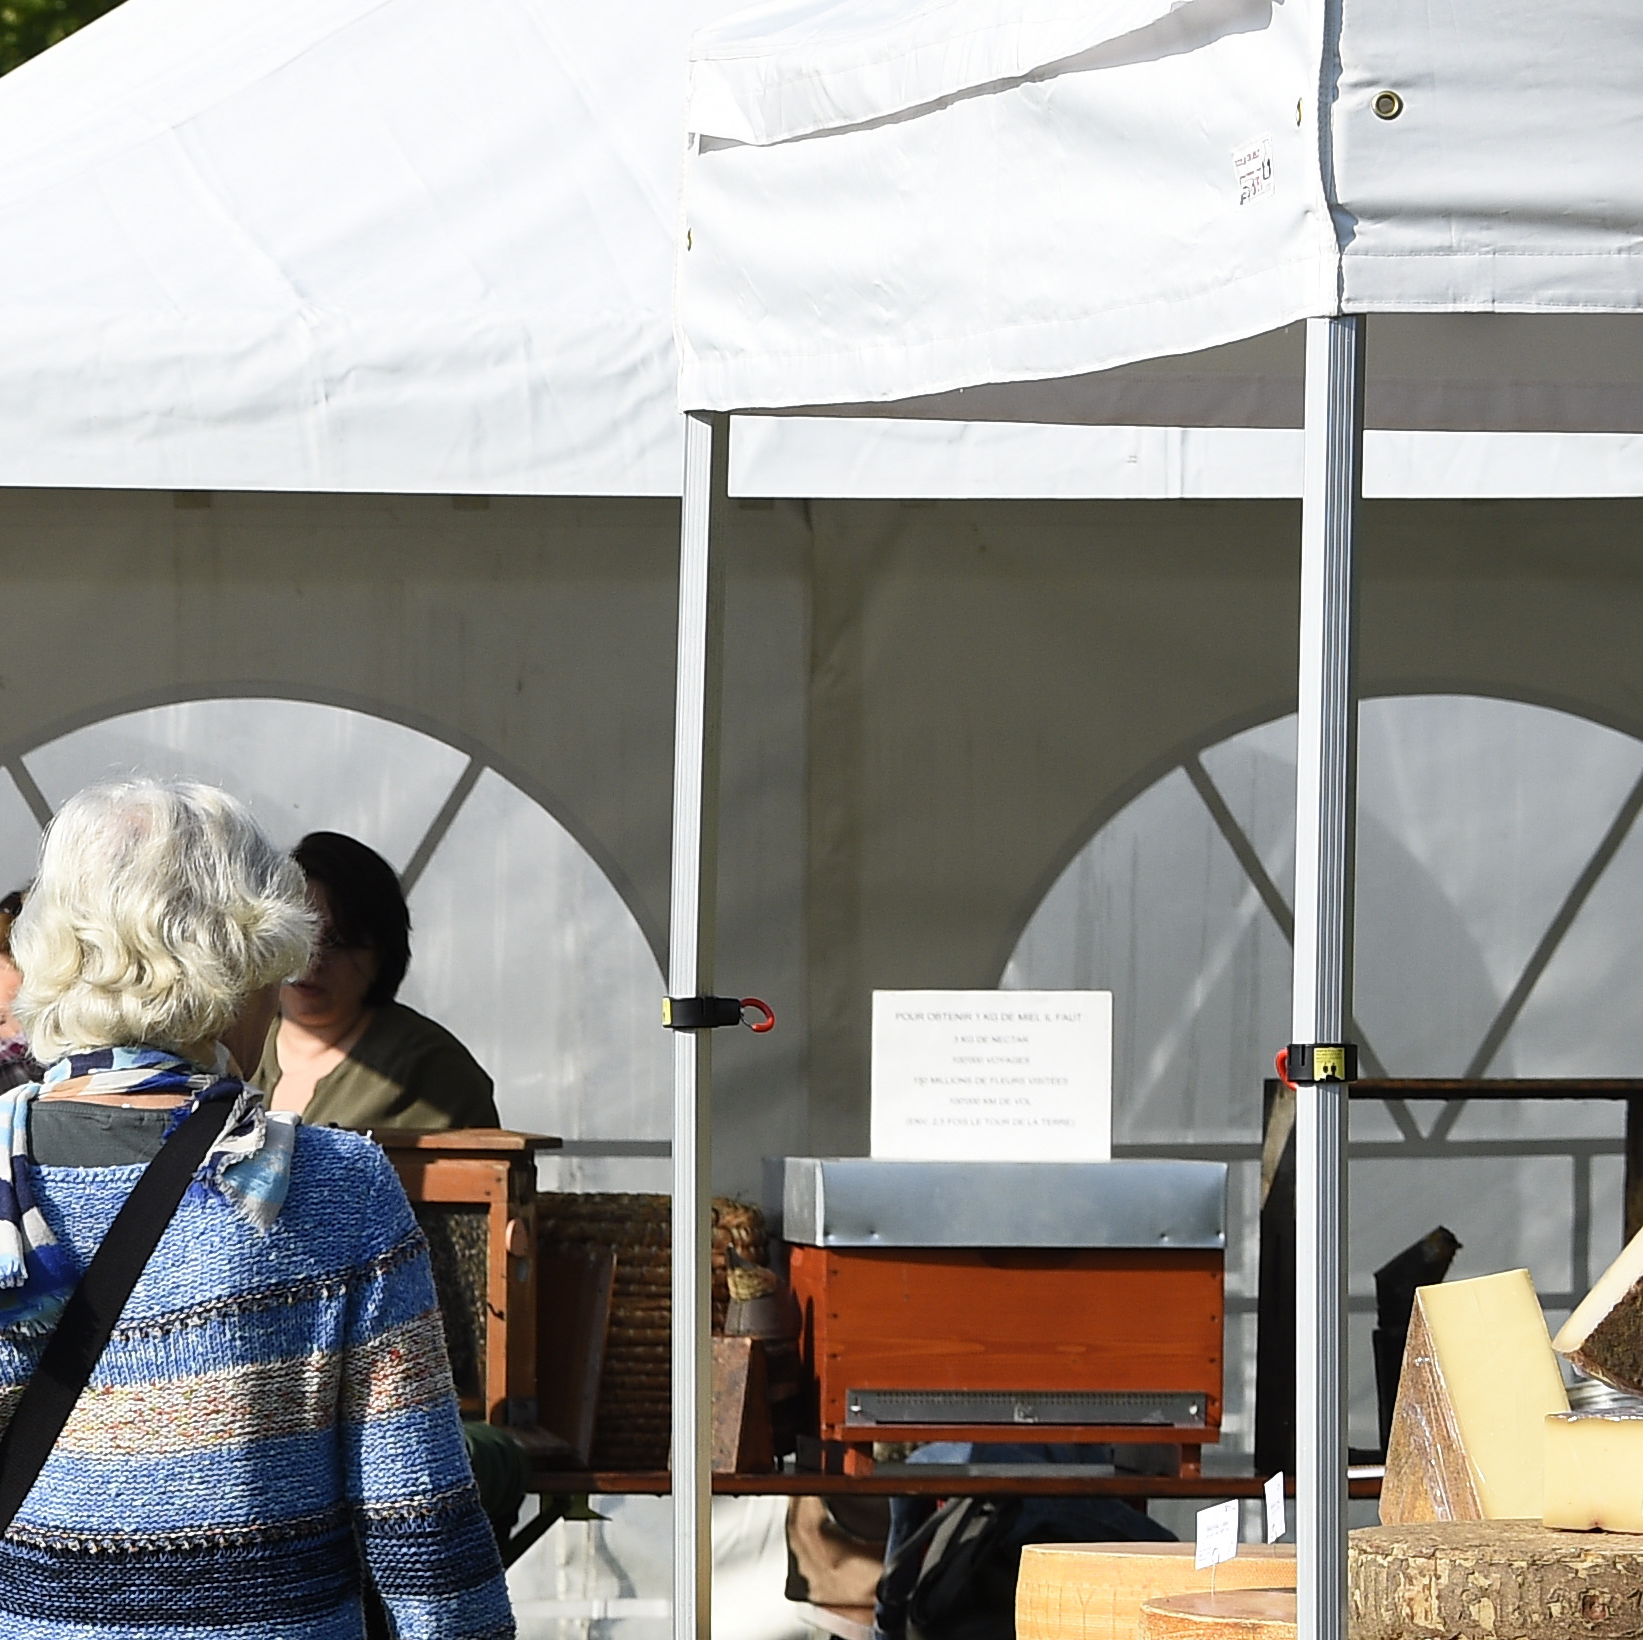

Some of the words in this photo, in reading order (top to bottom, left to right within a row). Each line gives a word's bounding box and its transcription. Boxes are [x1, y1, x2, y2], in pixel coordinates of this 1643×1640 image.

[895, 1012, 924, 1022] POUR
[927, 1012, 972, 1022] OBTENIR
[983, 1012, 998, 1022] KG
[1001, 1012, 1014, 1022] DE
[1055, 1012, 1082, 1022] FAUT
[961, 1035, 974, 1044] KG
[976, 1035, 988, 1044] DE
[991, 1035, 1029, 1044] NECTAR
[986, 1056, 1030, 1064] VOYAGES
[930, 1076, 972, 1085] MILLIONS
[974, 1076, 986, 1085] DE
[989, 1076, 1026, 1085] FLEURS
[983, 1097, 997, 1105] KM
[999, 1097, 1010, 1105] DE
[1014, 1097, 1031, 1105] VOL
[947, 1117, 969, 1126] FOIS
[971, 1117, 982, 1126] LE
[984, 1117, 1010, 1126] TOUR
[1012, 1117, 1023, 1126] DE
[1027, 1117, 1039, 1126] LA
